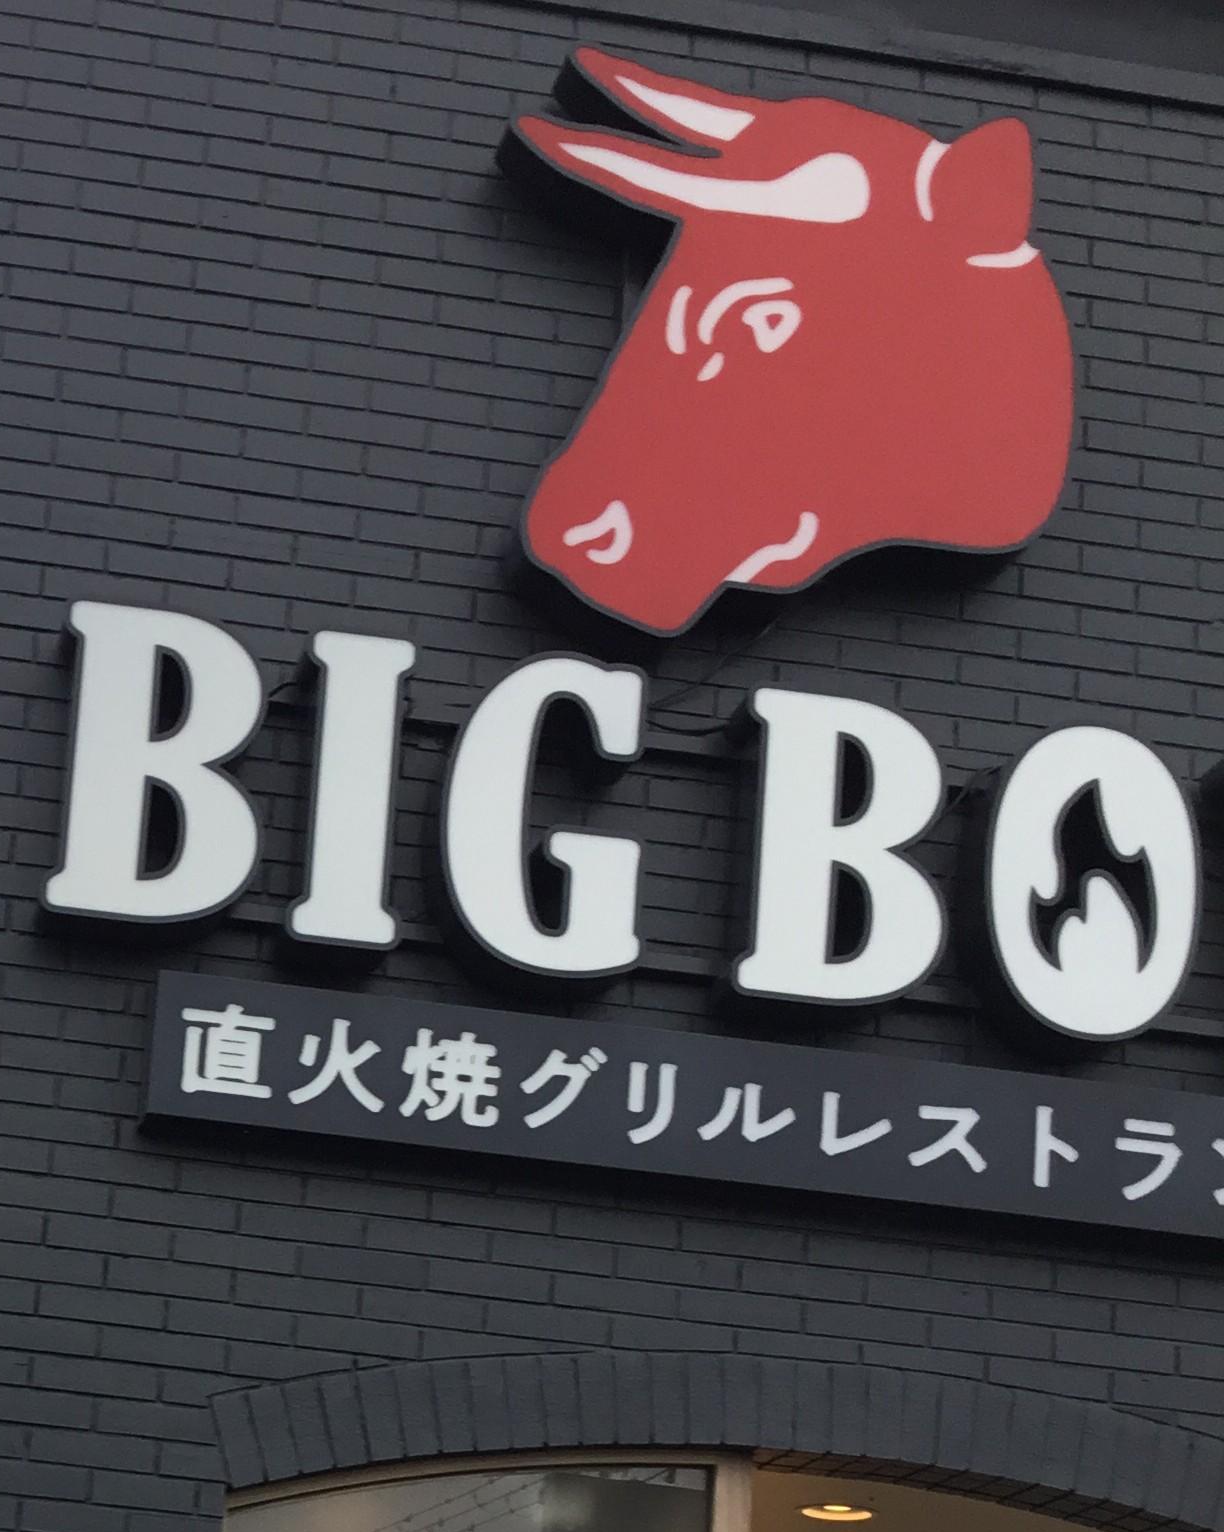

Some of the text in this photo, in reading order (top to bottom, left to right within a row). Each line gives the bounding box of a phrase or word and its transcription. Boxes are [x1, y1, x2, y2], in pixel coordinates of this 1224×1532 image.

[43, 600, 645, 976] BIG
[180, 1002, 1224, 1206] 直火焼グリルレストラ
